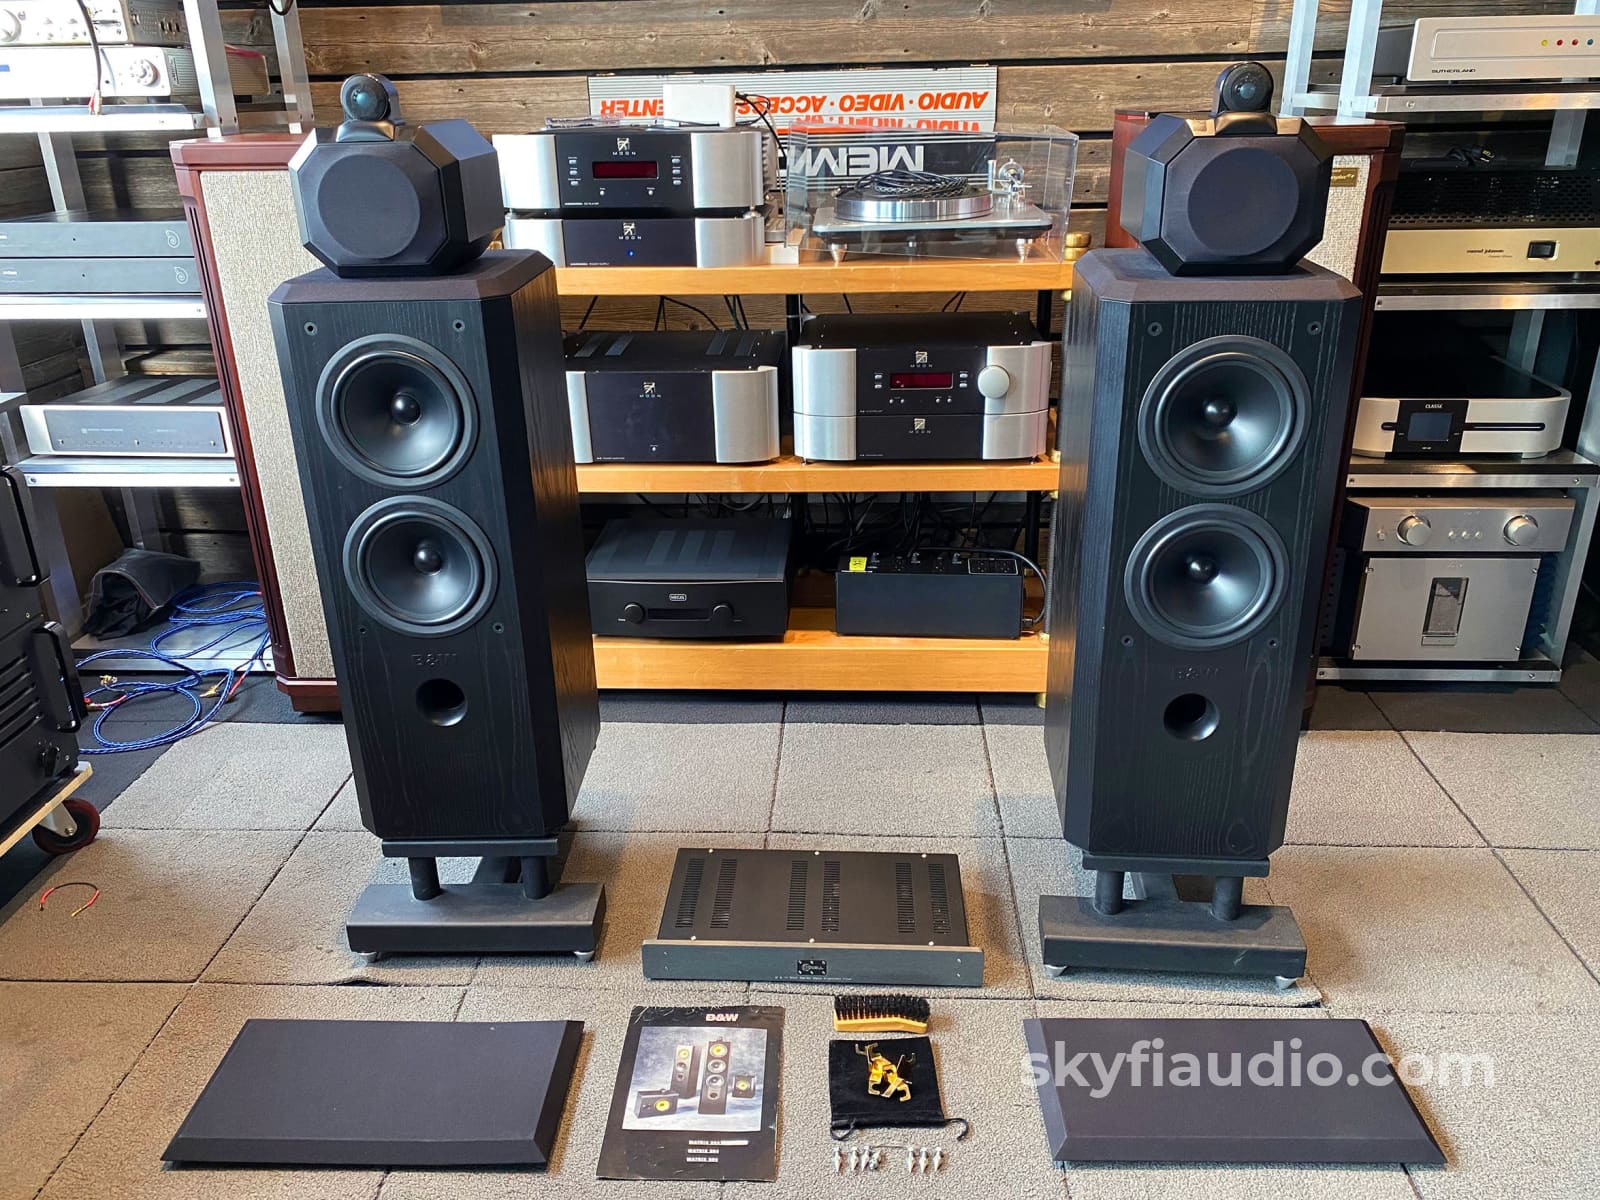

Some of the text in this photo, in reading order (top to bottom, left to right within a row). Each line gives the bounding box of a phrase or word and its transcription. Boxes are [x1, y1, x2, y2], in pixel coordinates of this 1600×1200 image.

[600, 97, 664, 117] ENTER
[838, 92, 905, 112] VIDEO
[918, 91, 989, 110] AUDIO
[705, 1013, 739, 1022] B&W
